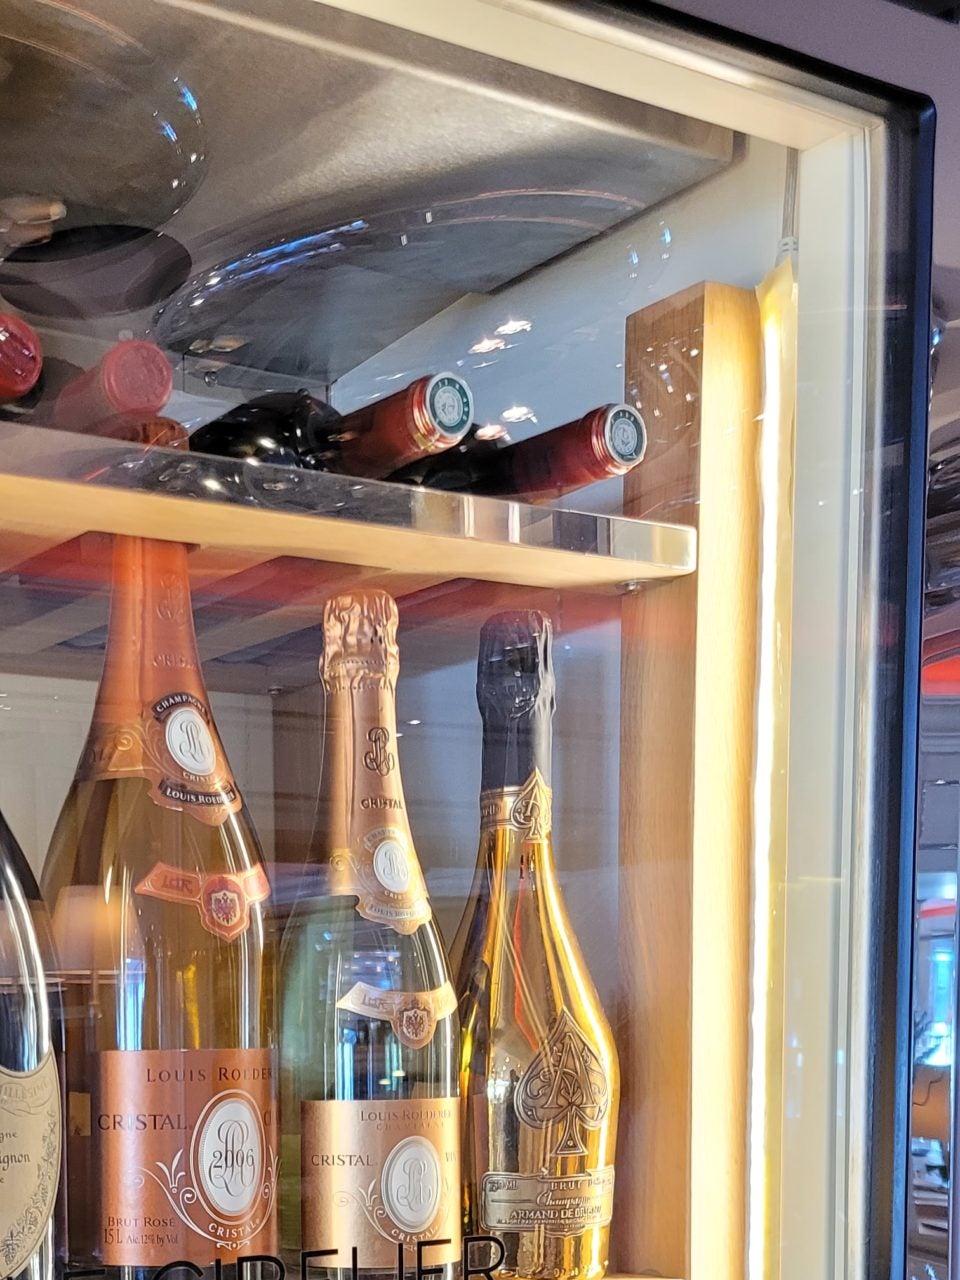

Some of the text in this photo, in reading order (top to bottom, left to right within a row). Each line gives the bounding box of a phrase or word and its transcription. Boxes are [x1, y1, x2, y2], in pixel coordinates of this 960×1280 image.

[166, 789, 196, 803] LOUIS
[360, 798, 403, 810] CRISTAL
[146, 1068, 206, 1083] LOUIS
[97, 1113, 189, 1131] CRISTAL
[360, 1110, 399, 1122] LOUIS
[212, 1148, 255, 1169] 2006
[311, 1154, 375, 1167] CRISTAL
[551, 1180, 582, 1190] BRUT
[510, 1208, 559, 1219] ARMAND
[560, 1209, 575, 1219] DE
[108, 1216, 139, 1227] BRUT
[208, 1222, 257, 1239] CRISTAL
[391, 1226, 438, 1243] CRISTAL
[156, 1234, 166, 1247] by
